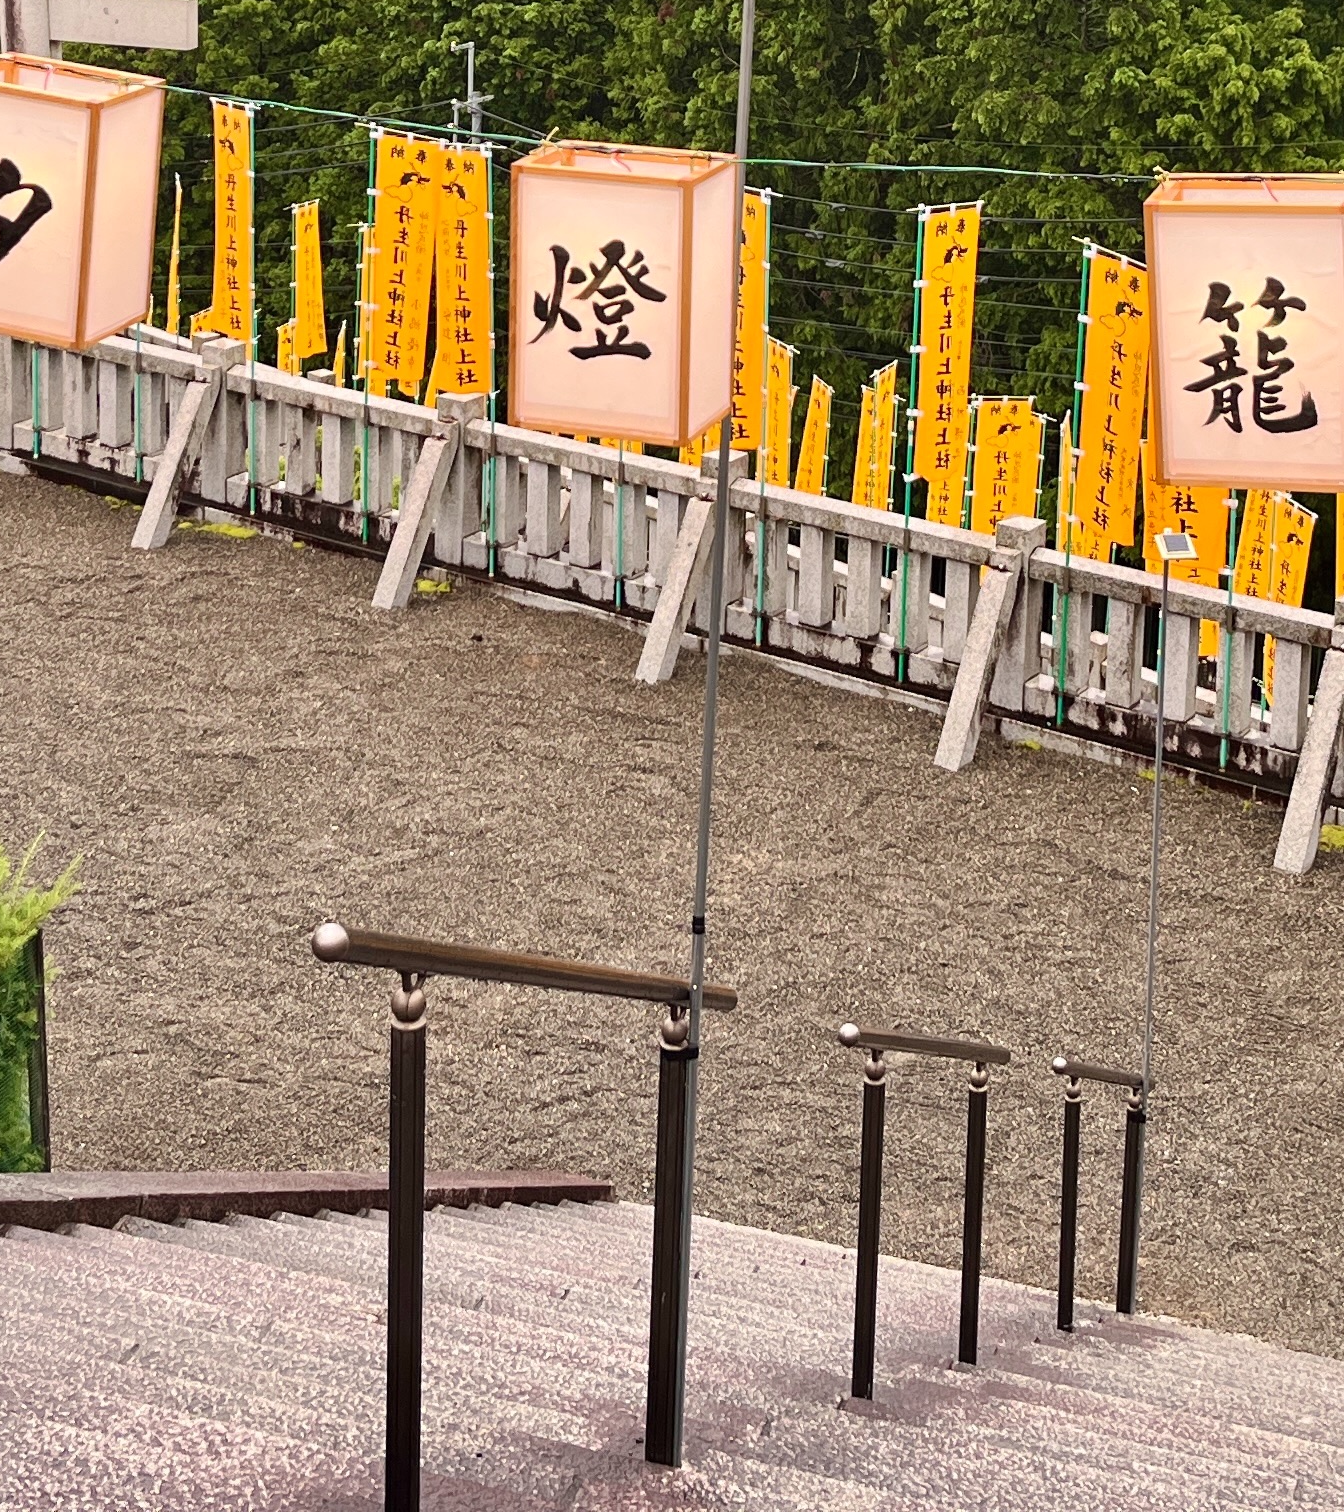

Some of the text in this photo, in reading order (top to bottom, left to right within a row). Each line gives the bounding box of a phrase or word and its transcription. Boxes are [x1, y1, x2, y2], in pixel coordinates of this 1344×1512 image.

[446, 158, 474, 173] 奉納
[224, 174, 242, 331] 丹生川上神社上社
[455, 220, 478, 386] 丹生川上神社上社
[531, 241, 666, 360] 燈
[1184, 278, 1317, 433] 籠
